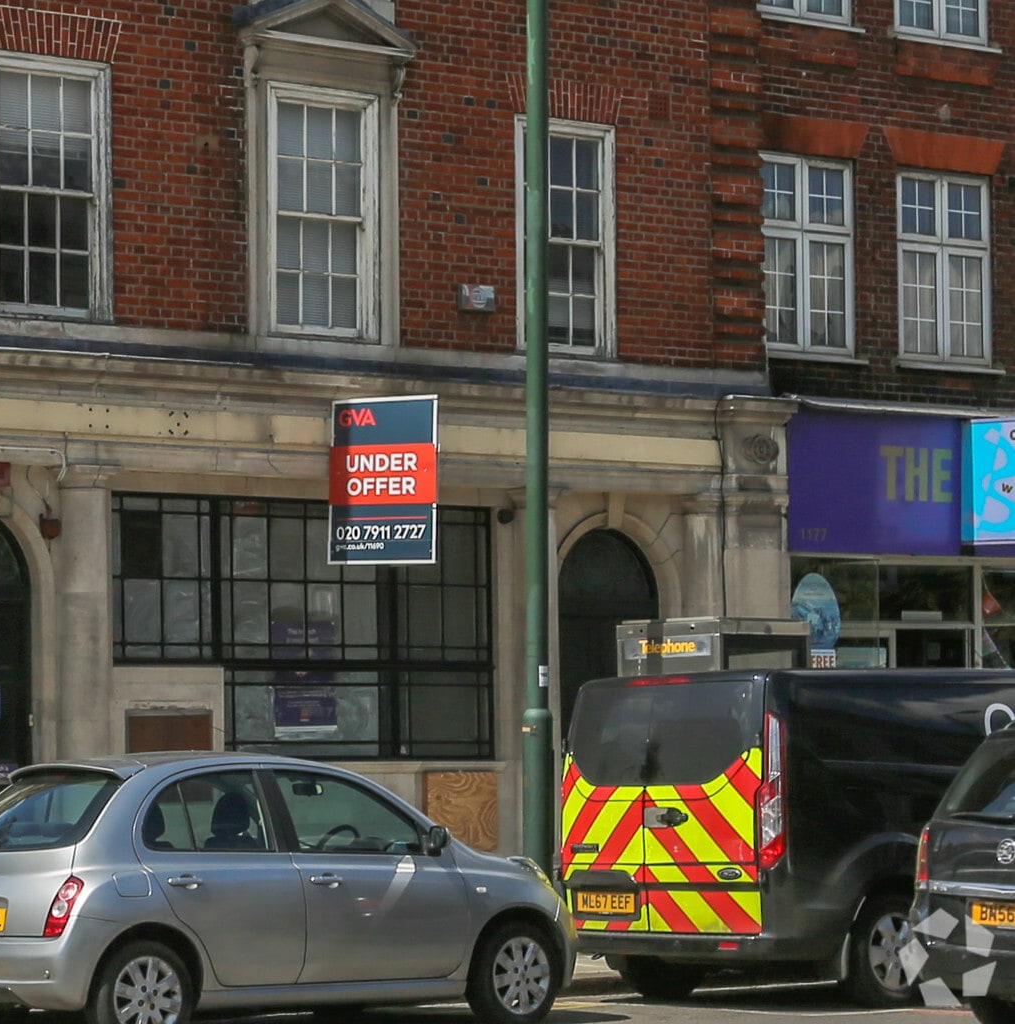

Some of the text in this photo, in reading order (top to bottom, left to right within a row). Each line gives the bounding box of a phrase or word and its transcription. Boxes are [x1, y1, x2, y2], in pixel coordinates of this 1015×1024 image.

[339, 408, 377, 427] GVA
[346, 453, 418, 473] UNDER
[879, 445, 953, 503] THE
[346, 477, 416, 496] OFFER
[336, 524, 427, 540] 020 7911 2727
[639, 638, 696, 656] Telephone
[811, 655, 835, 668] FREE
[582, 894, 631, 909] ML67 EEF
